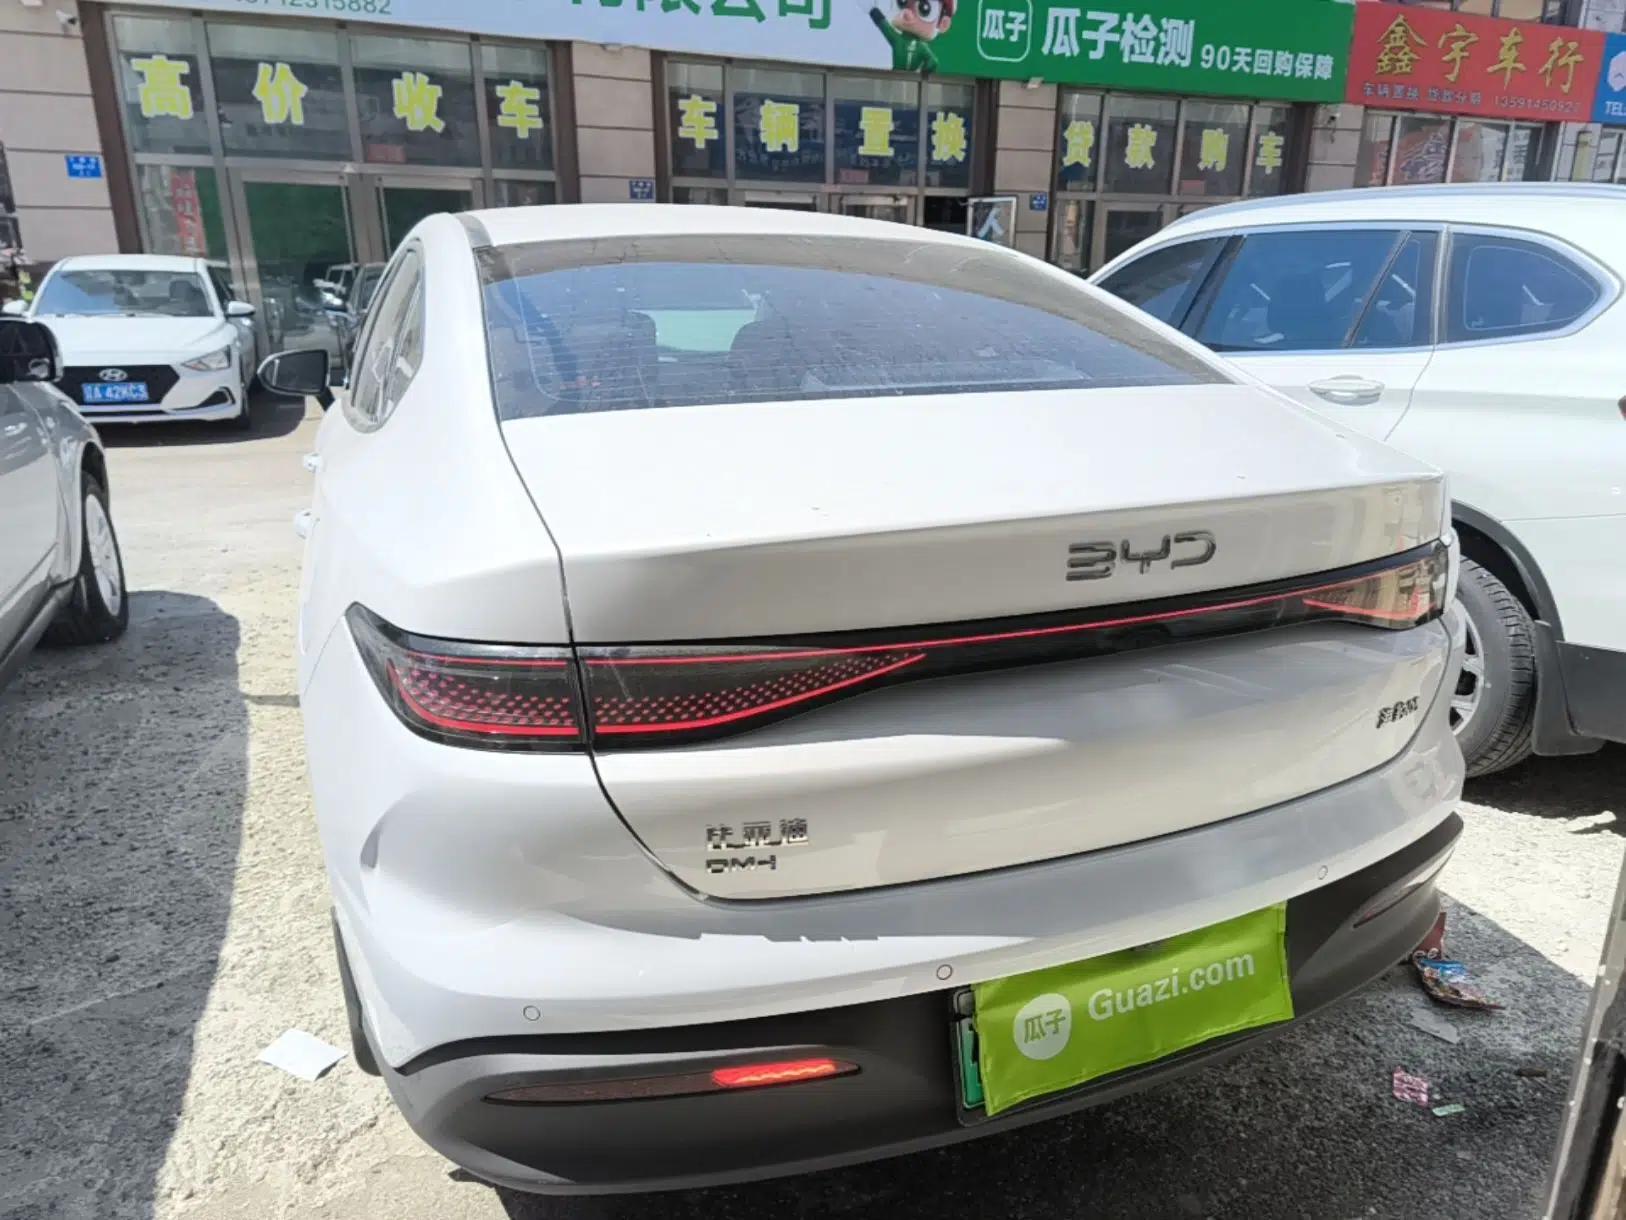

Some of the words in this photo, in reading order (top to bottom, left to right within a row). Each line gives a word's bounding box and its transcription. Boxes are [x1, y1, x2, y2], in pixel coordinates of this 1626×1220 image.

[982, 9, 1027, 42] 瓜子
[1041, 7, 1195, 68] 瓜子检测
[1201, 44, 1335, 81] 90天回购保障
[1375, 13, 1584, 94] 鑫宇车行
[130, 54, 543, 139] 高价收车
[677, 94, 967, 163] 车辆置换
[1062, 120, 1285, 175] 贷款购车
[1066, 530, 1217, 581] BYD
[1022, 1007, 1067, 1044] 瓜子
[1088, 952, 1256, 1021] Guazi.com
